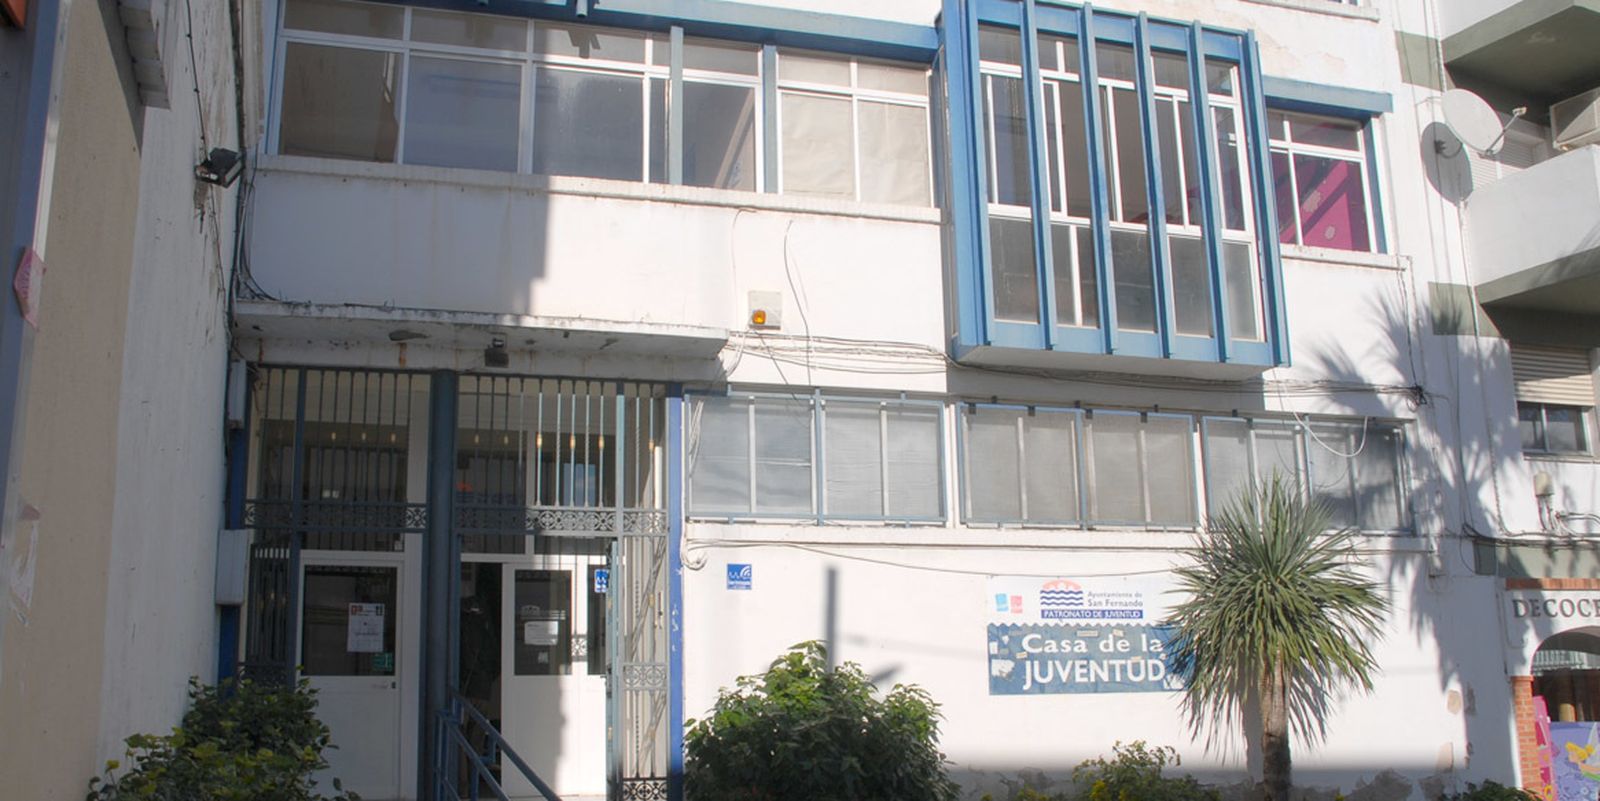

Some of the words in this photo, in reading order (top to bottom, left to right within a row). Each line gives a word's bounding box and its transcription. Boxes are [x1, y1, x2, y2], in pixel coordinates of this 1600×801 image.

[1088, 591, 1132, 599] Ayuntamiento
[1087, 599, 1102, 607] San
[1105, 599, 1143, 607] Fernando
[1044, 610, 1092, 618] PATRONATO
[1093, 610, 1102, 618] DE
[1104, 610, 1141, 618] JUVENTUD
[1022, 634, 1088, 653] Casa
[1099, 634, 1130, 653] de
[1141, 634, 1163, 652] la
[1023, 659, 1166, 690] JUVENTUD
